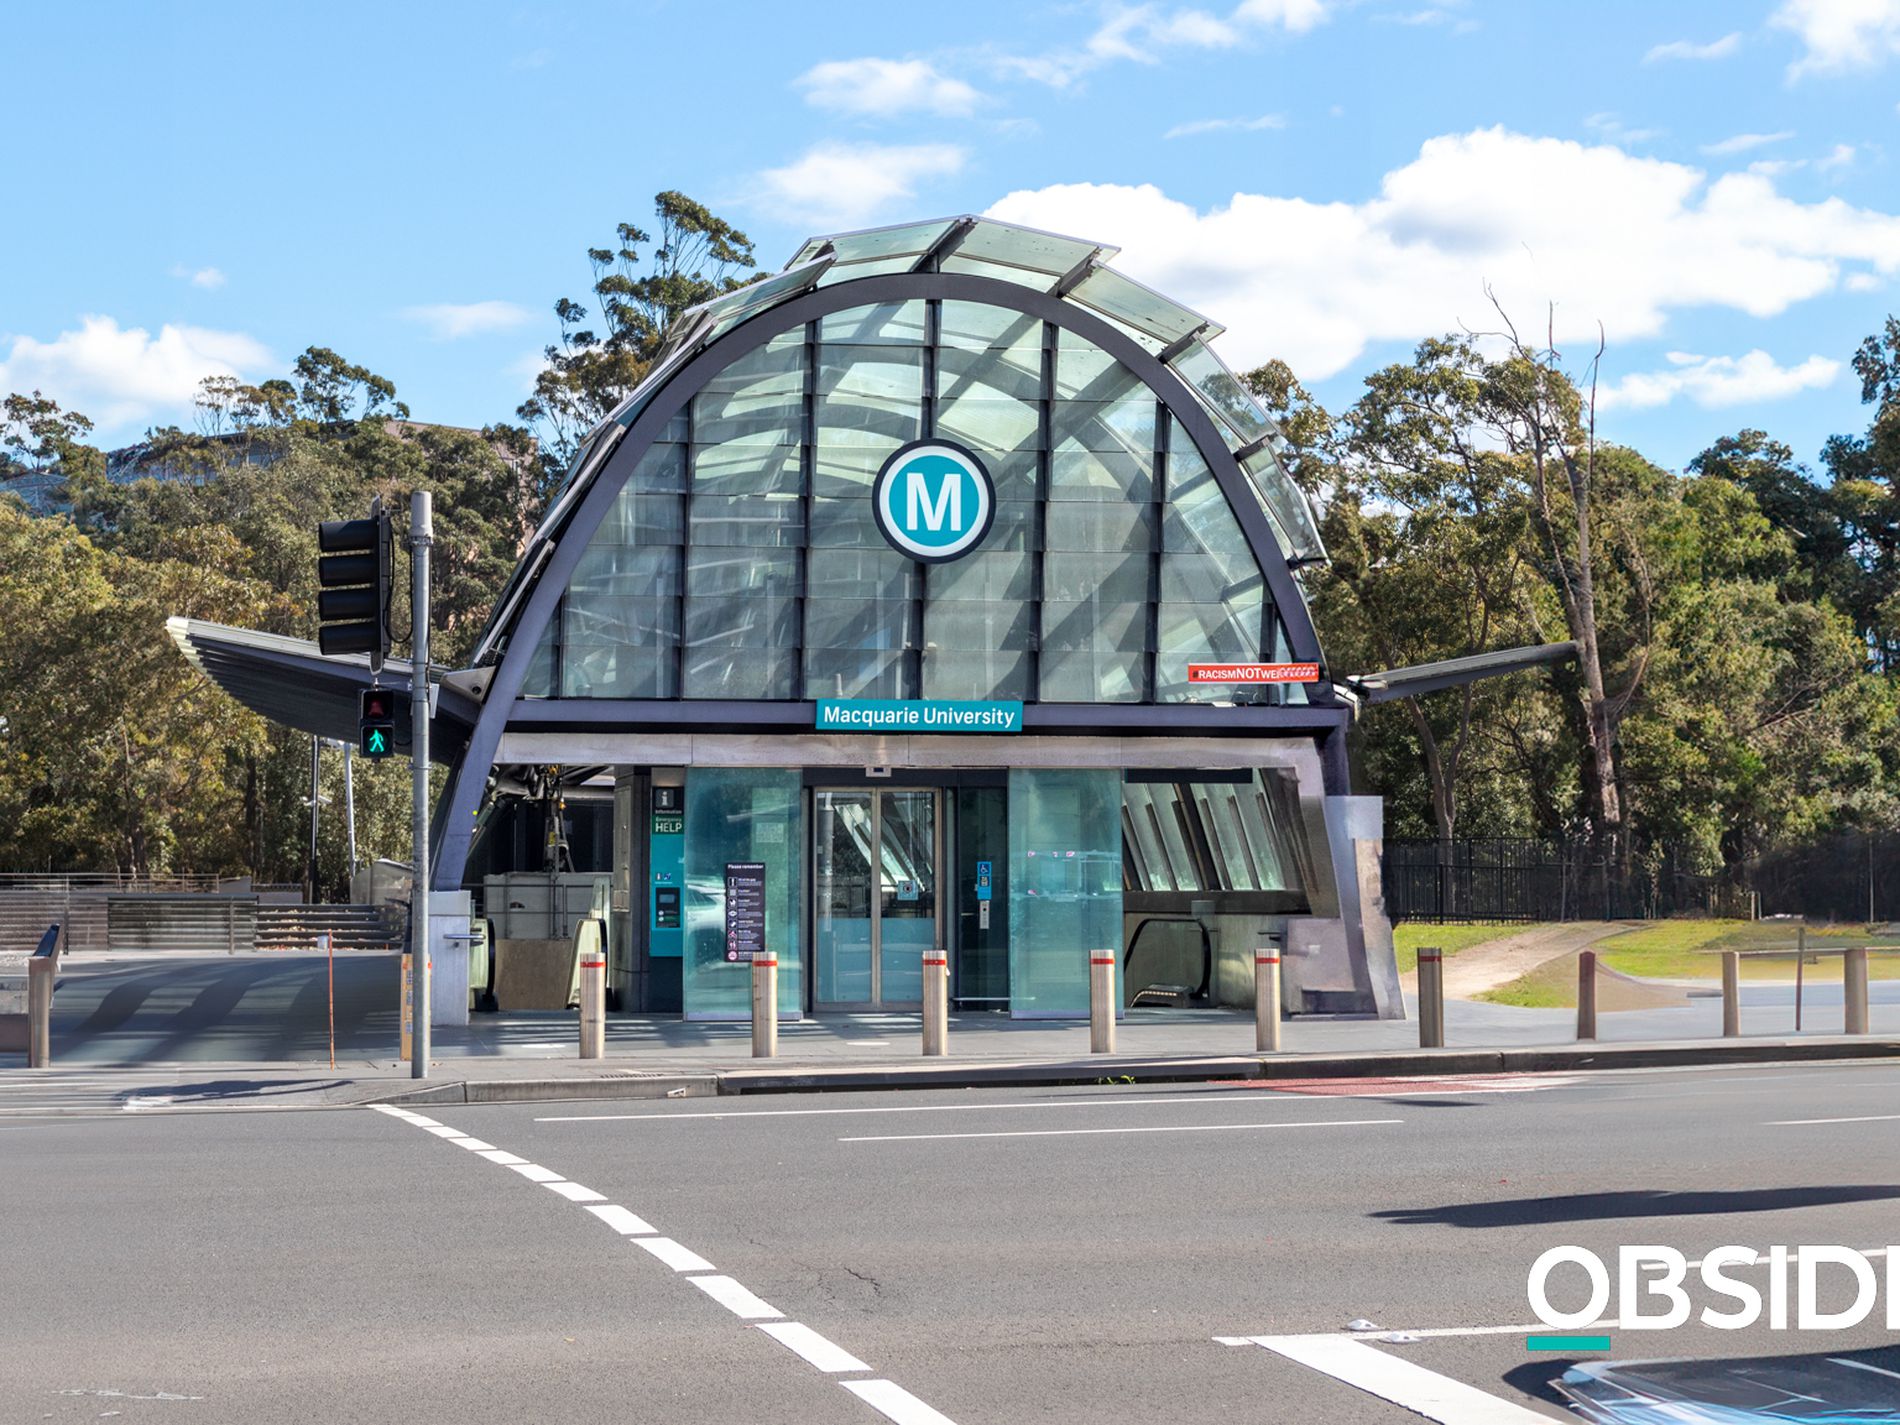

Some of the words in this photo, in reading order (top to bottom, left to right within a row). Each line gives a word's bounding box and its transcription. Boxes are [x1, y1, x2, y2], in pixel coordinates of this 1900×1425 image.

[906, 472, 962, 532] M
[823, 706, 920, 728] Macquarie
[923, 707, 1015, 729] University
[655, 822, 683, 833] HELP
